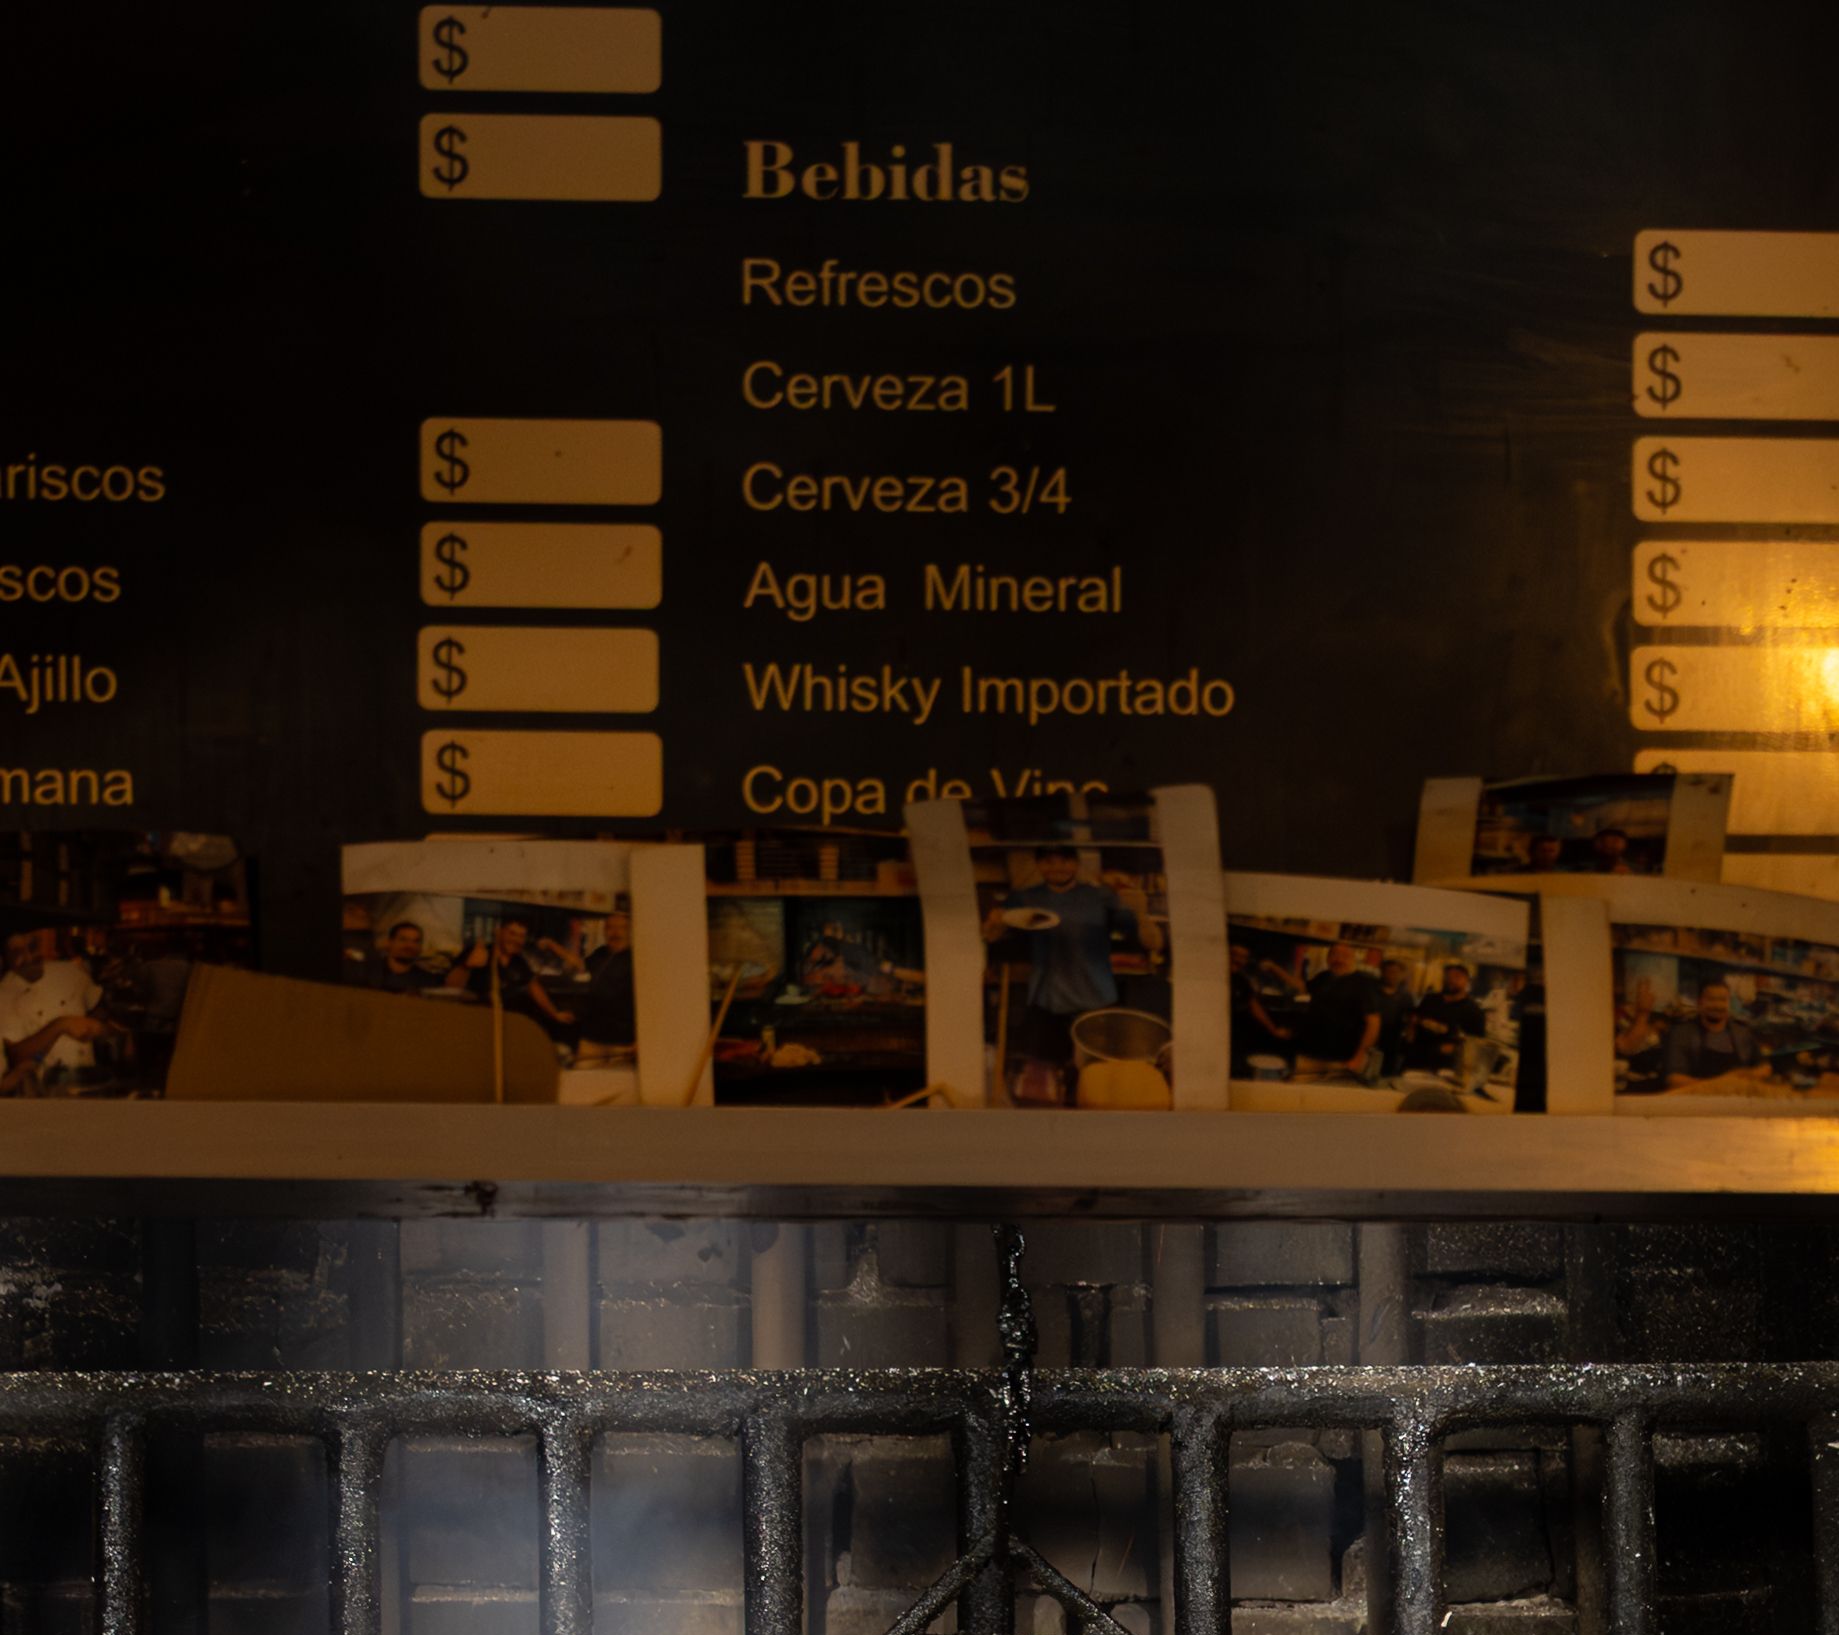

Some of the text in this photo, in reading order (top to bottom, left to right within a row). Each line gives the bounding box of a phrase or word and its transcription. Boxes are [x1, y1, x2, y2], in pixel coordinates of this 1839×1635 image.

[744, 140, 1029, 202] Bebidas
[742, 258, 1017, 309] Refrescos
[742, 360, 1056, 412] Cerveza 1L
[0, 453, 167, 502] riscos
[742, 462, 1072, 514] Cerveza 3/4
[743, 561, 1122, 622] Agua Mineral
[0, 653, 118, 715] Ajillo
[743, 663, 1236, 725] Whisky Importado
[742, 765, 887, 827] Copa
